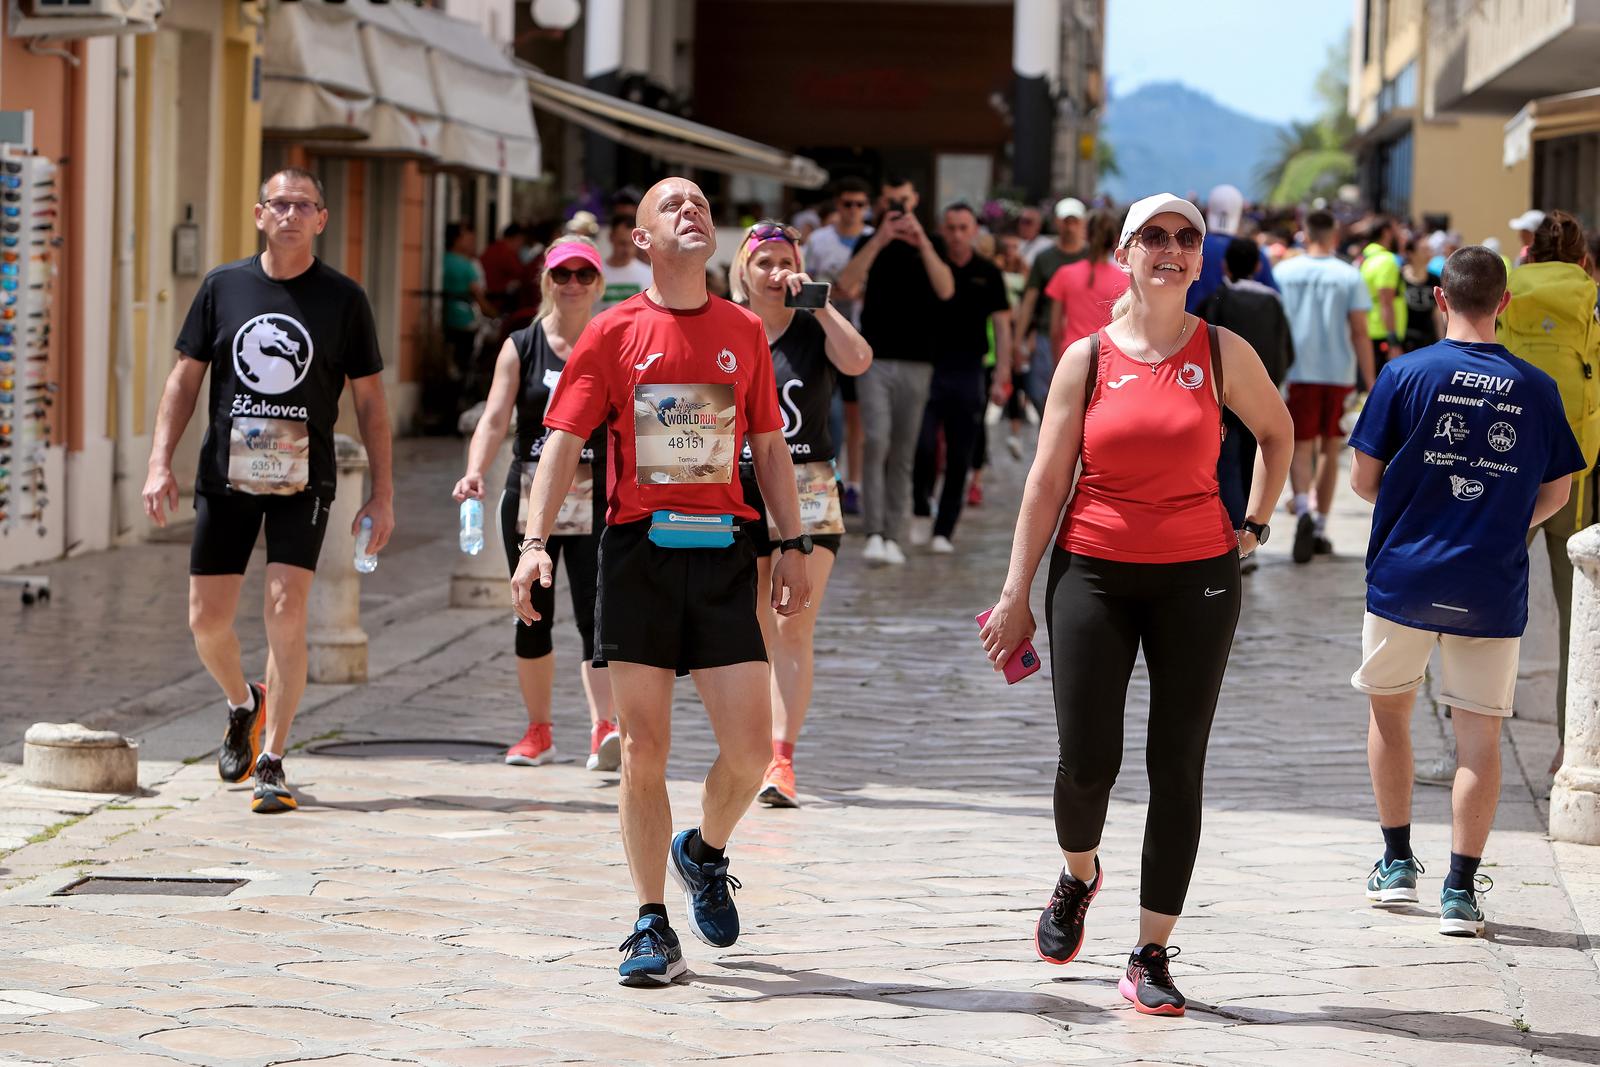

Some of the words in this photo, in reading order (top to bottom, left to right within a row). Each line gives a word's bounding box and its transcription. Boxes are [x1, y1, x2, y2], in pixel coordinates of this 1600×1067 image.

[1451, 370, 1514, 393] FERIVI
[1438, 394, 1484, 406] RUNNING
[1496, 402, 1523, 415] GATE
[668, 436, 705, 449] 48151
[1436, 452, 1468, 463] Raiffeisen
[1436, 459, 1455, 467] BANK
[251, 460, 283, 471] 53511
[1470, 457, 1519, 474] Jamnica
[1466, 484, 1481, 494] ledo
